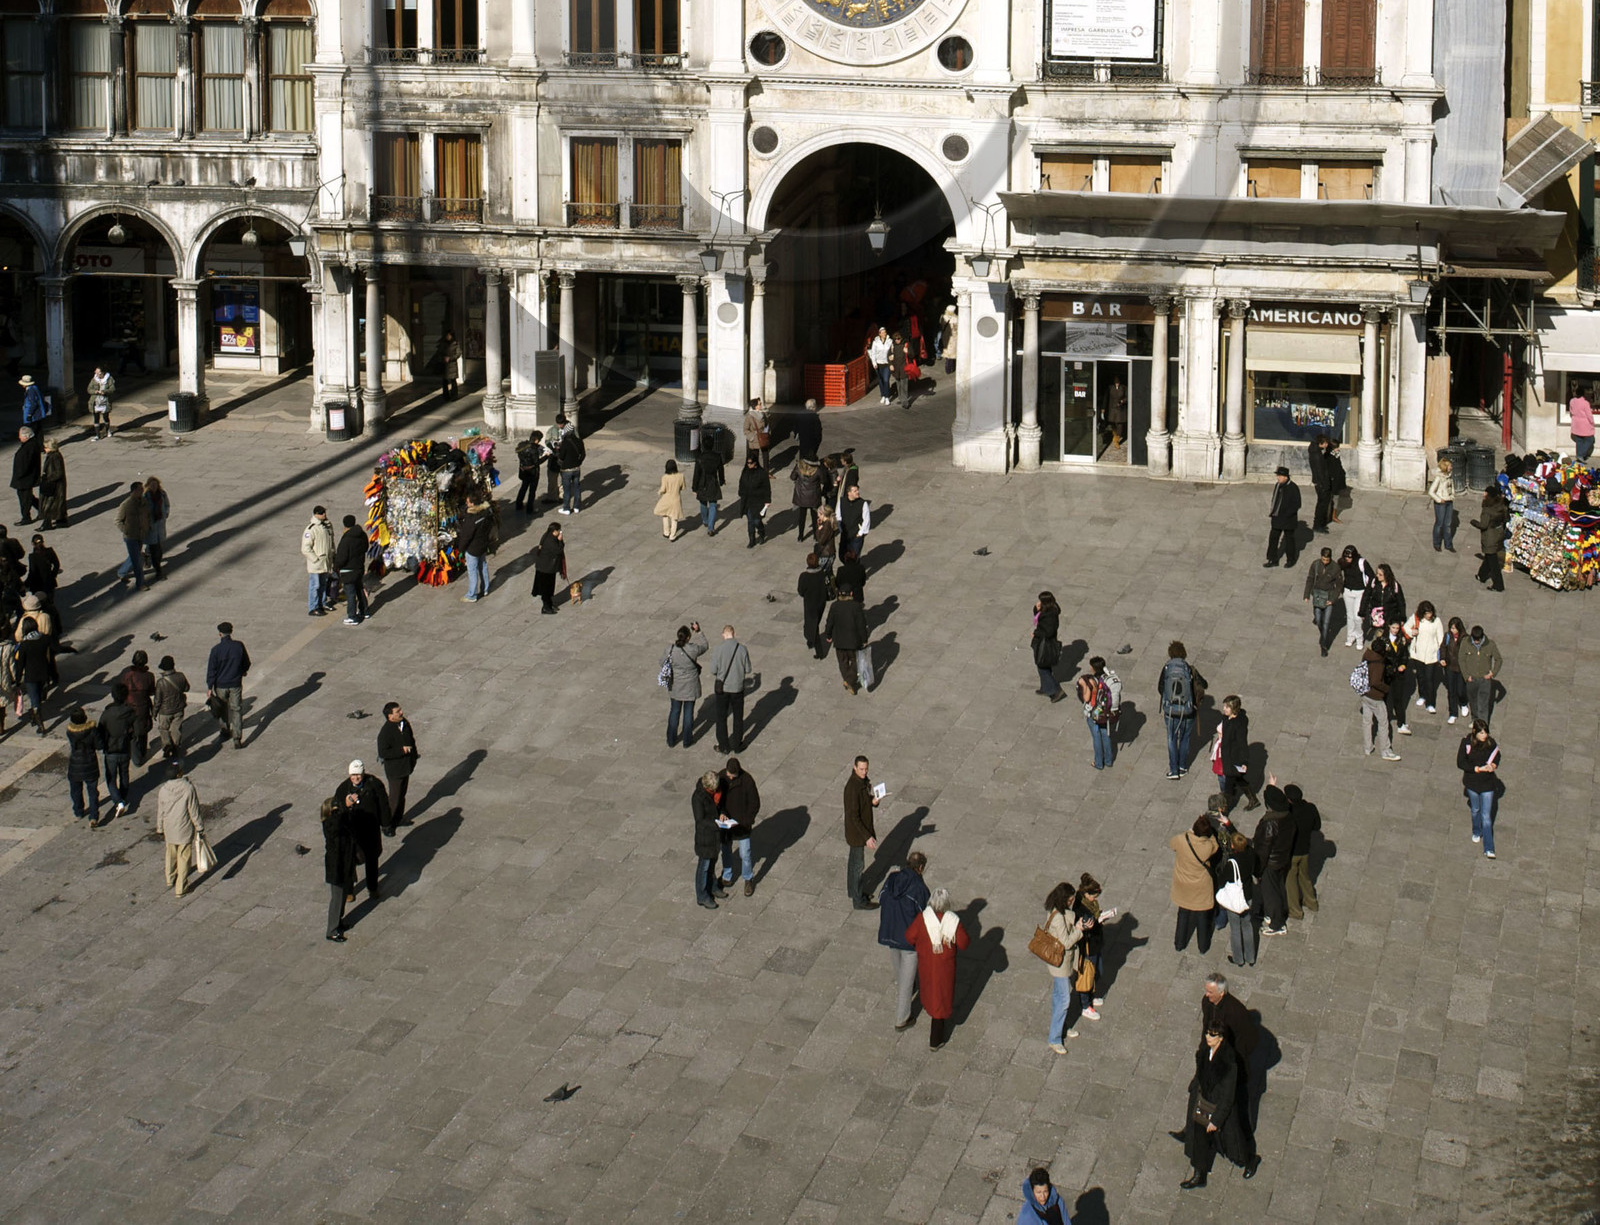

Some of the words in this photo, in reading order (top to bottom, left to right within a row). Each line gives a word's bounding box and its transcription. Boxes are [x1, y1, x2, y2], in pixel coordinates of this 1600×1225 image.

[72, 254, 112, 267] OTO
[1072, 302, 1121, 316] BAR
[1248, 308, 1361, 325] AMERICANO
